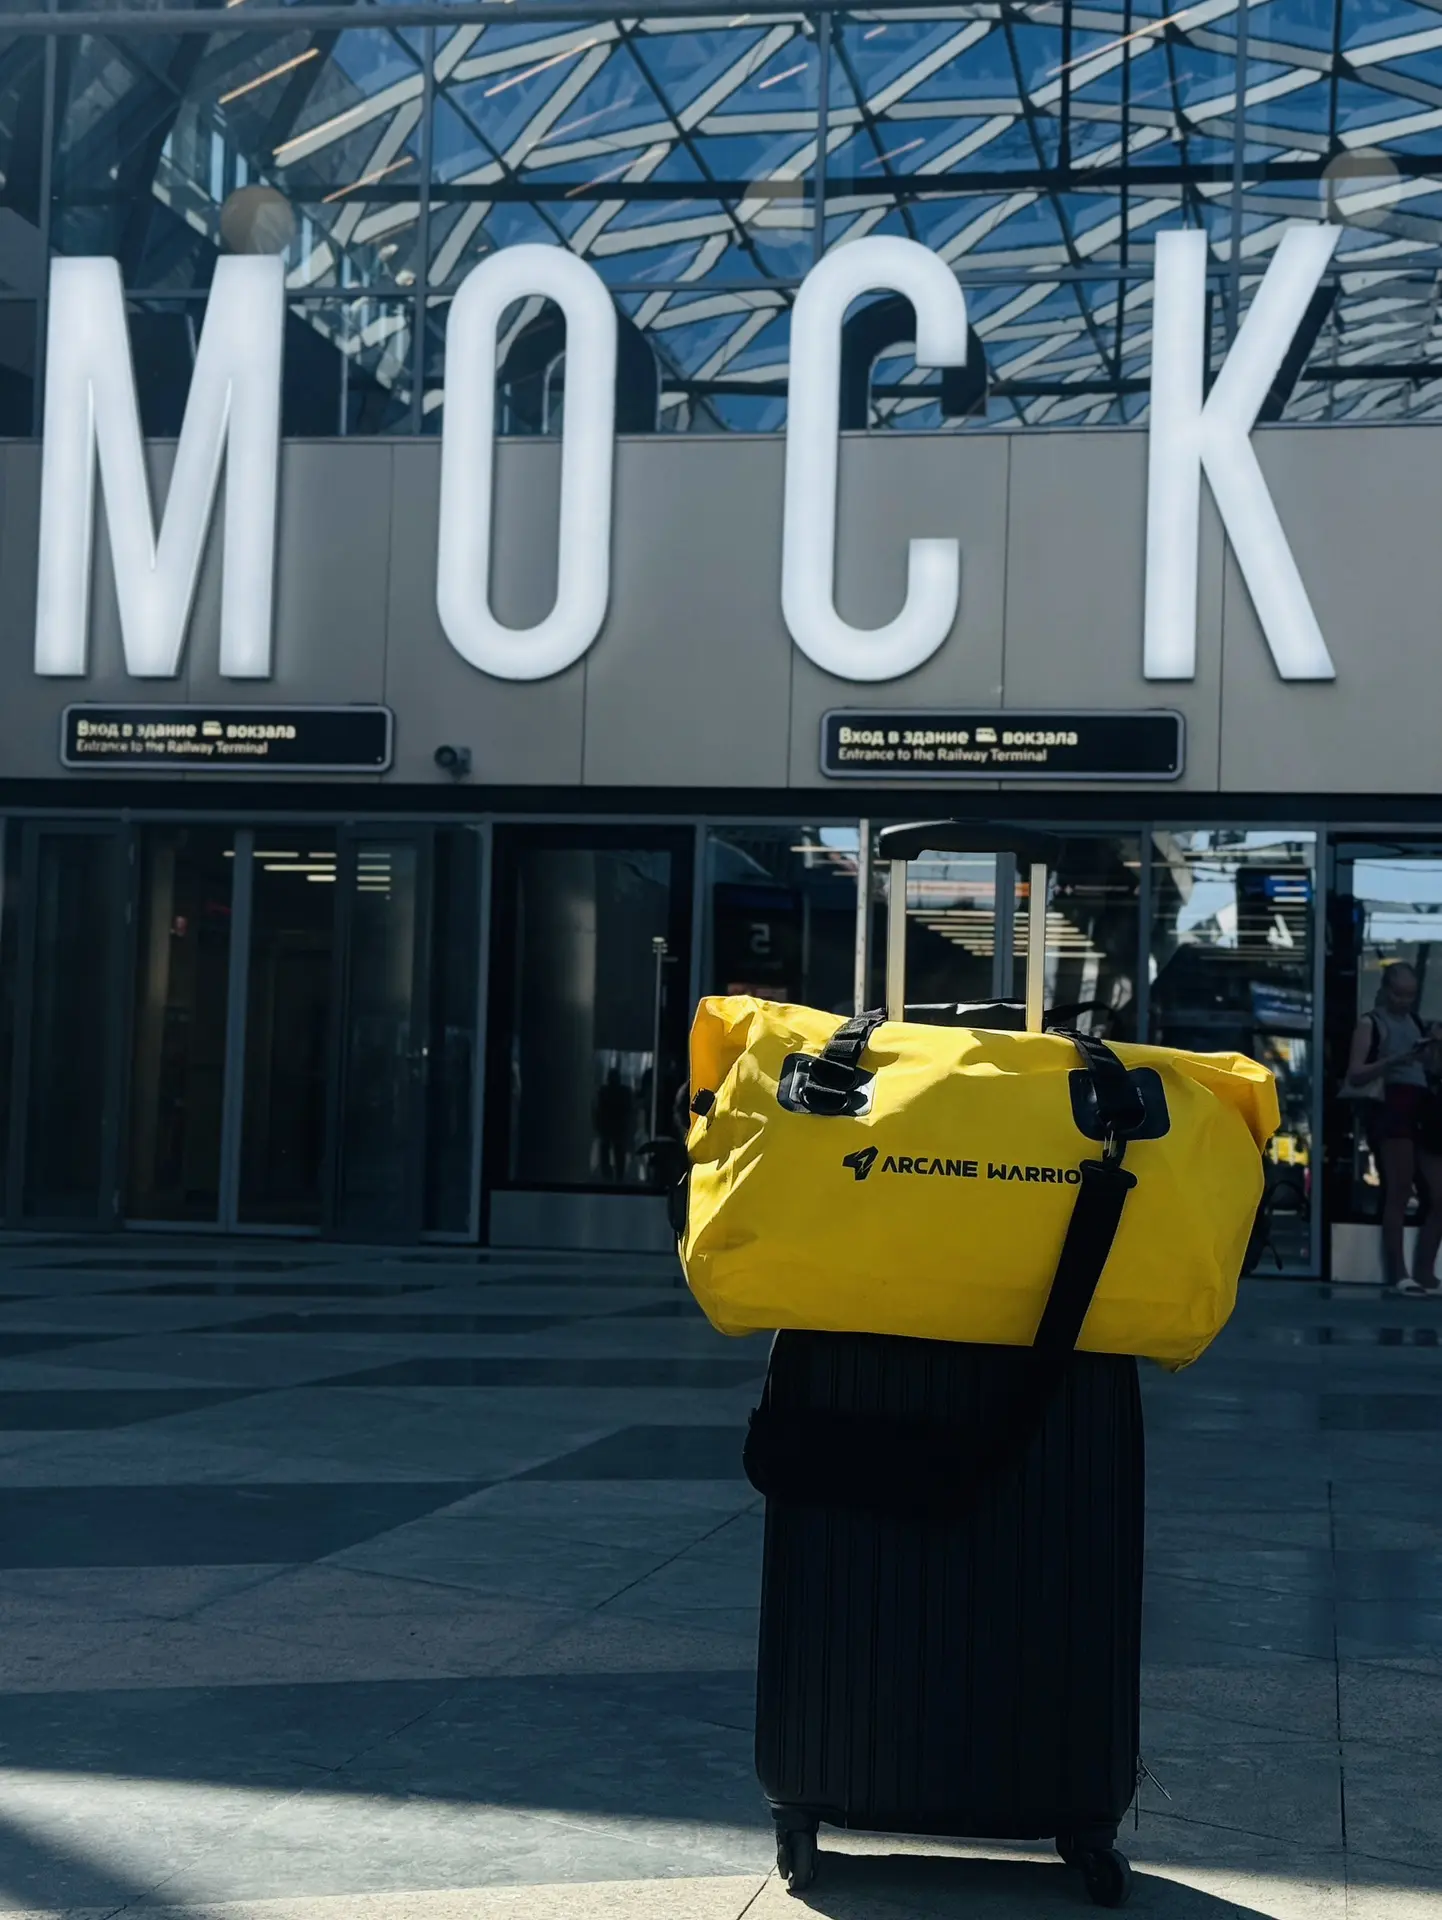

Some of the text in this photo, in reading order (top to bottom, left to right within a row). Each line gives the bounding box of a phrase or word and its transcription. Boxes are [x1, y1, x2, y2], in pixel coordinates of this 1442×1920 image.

[33, 223, 1343, 682] МОСК
[76, 719, 297, 739] Вход в здание вокзала
[838, 726, 1078, 746] Вход в здание вокзала
[76, 739, 269, 755] Entrance to the Railway Terminal
[838, 747, 1048, 763] Entrance to the Railway Terminal
[881, 1155, 978, 1178] ARCANE
